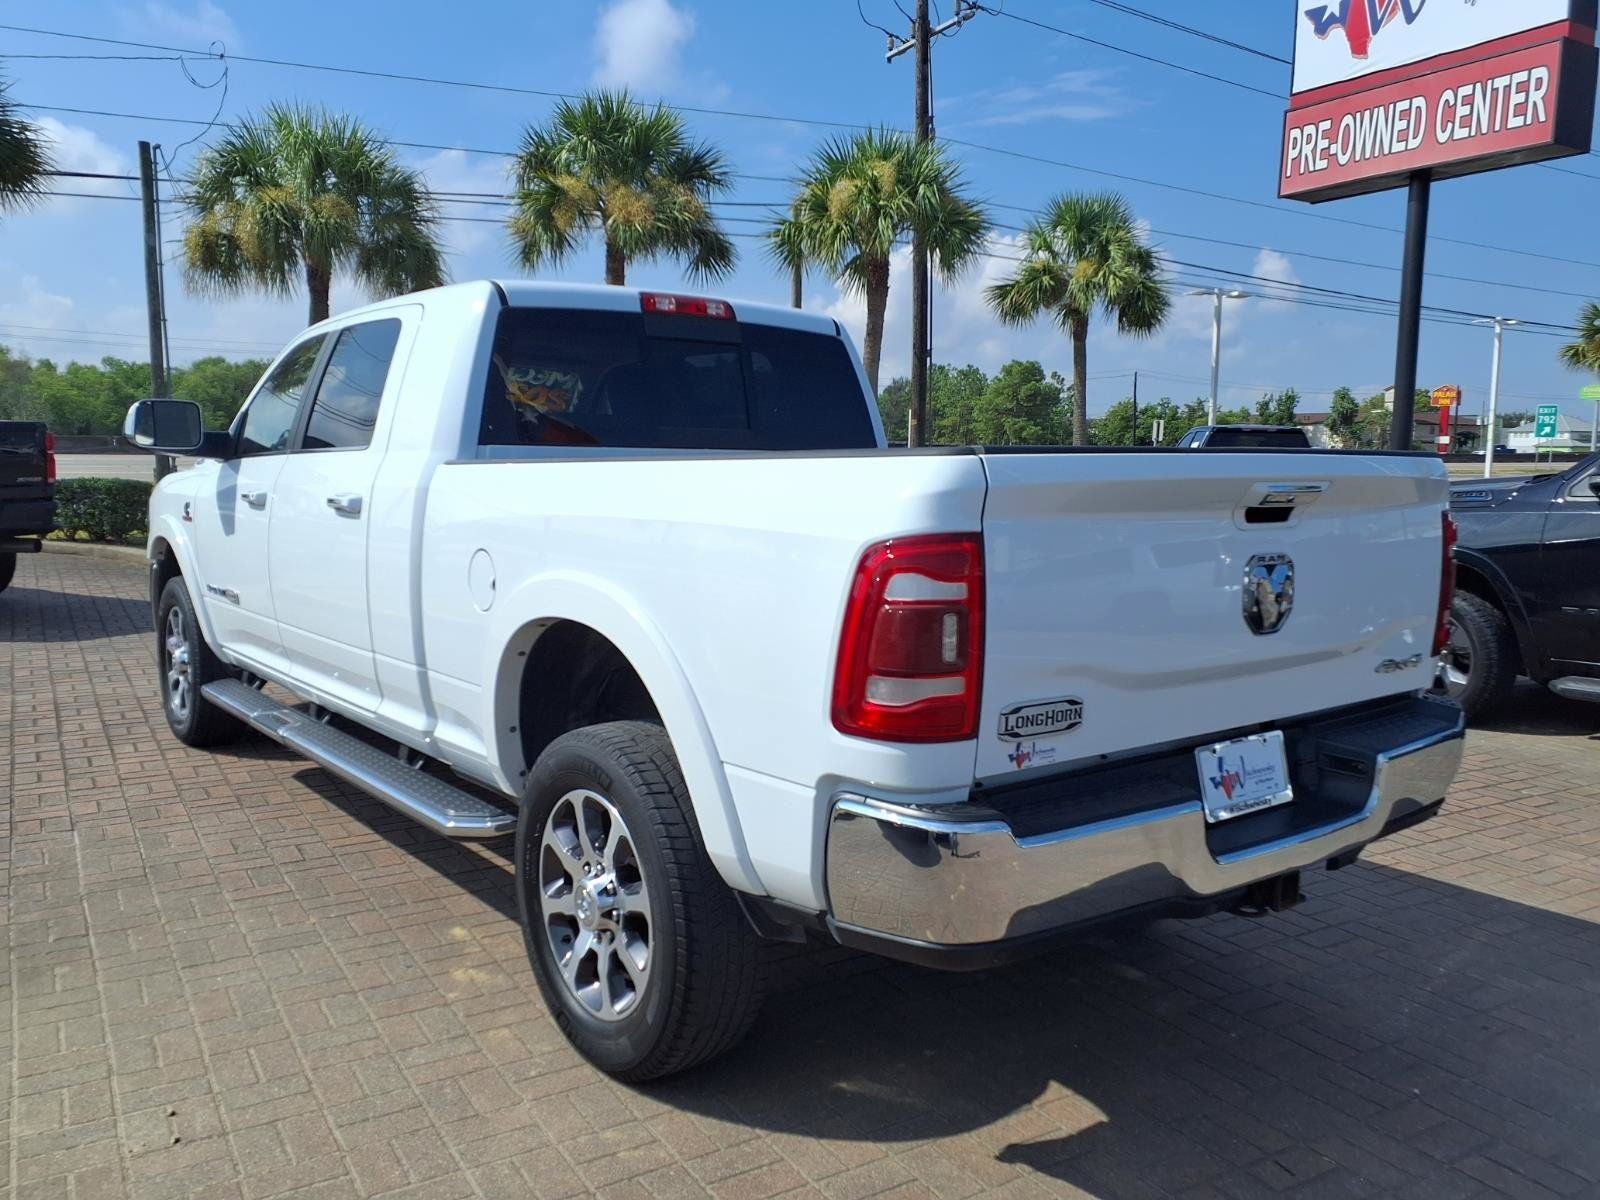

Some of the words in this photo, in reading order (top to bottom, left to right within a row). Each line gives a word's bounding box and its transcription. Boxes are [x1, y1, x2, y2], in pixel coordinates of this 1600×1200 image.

[1285, 95, 1428, 179] PRE-OWNED
[1434, 65, 1550, 145] CENTER
[1538, 415, 1556, 424] 792
[1004, 706, 1083, 733] LONGHORN
